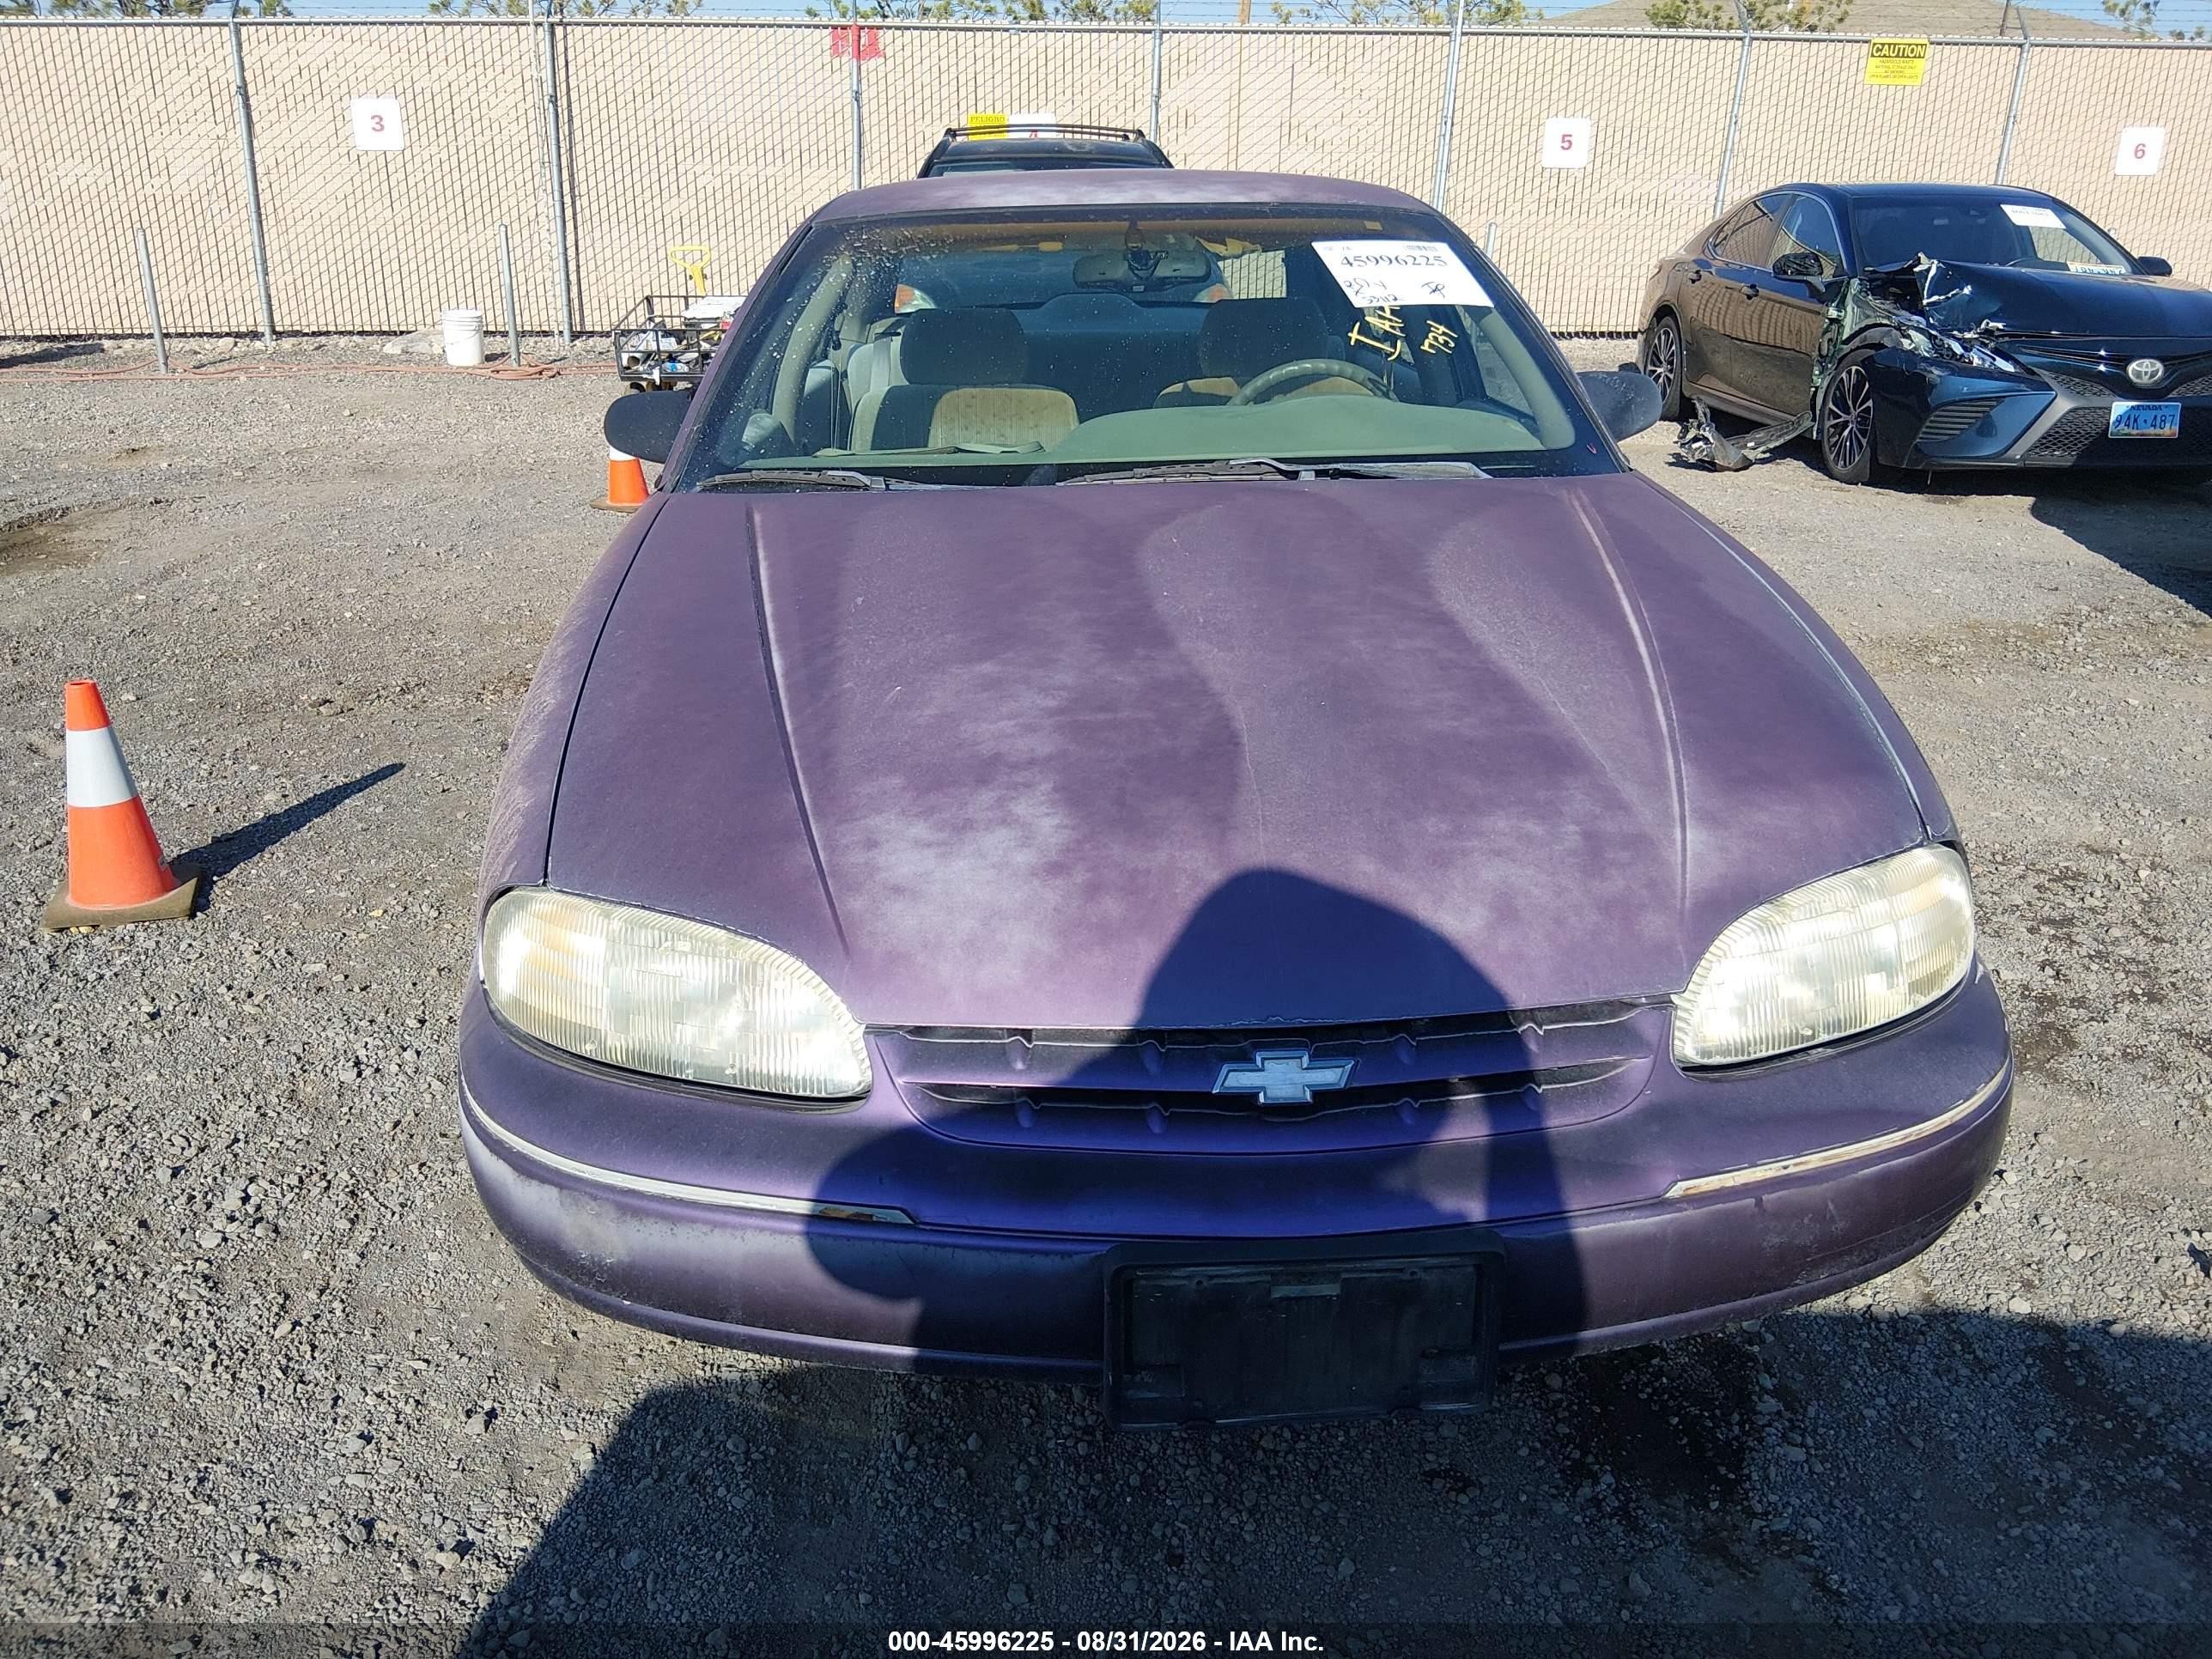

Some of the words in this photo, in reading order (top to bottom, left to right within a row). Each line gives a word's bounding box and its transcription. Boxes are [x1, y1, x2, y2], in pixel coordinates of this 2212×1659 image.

[1872, 44, 1926, 58] CAUTION
[370, 114, 385, 132] 3
[1560, 134, 1573, 150] 5
[2133, 143, 2147, 160] 6
[1340, 254, 1448, 268] 45996225
